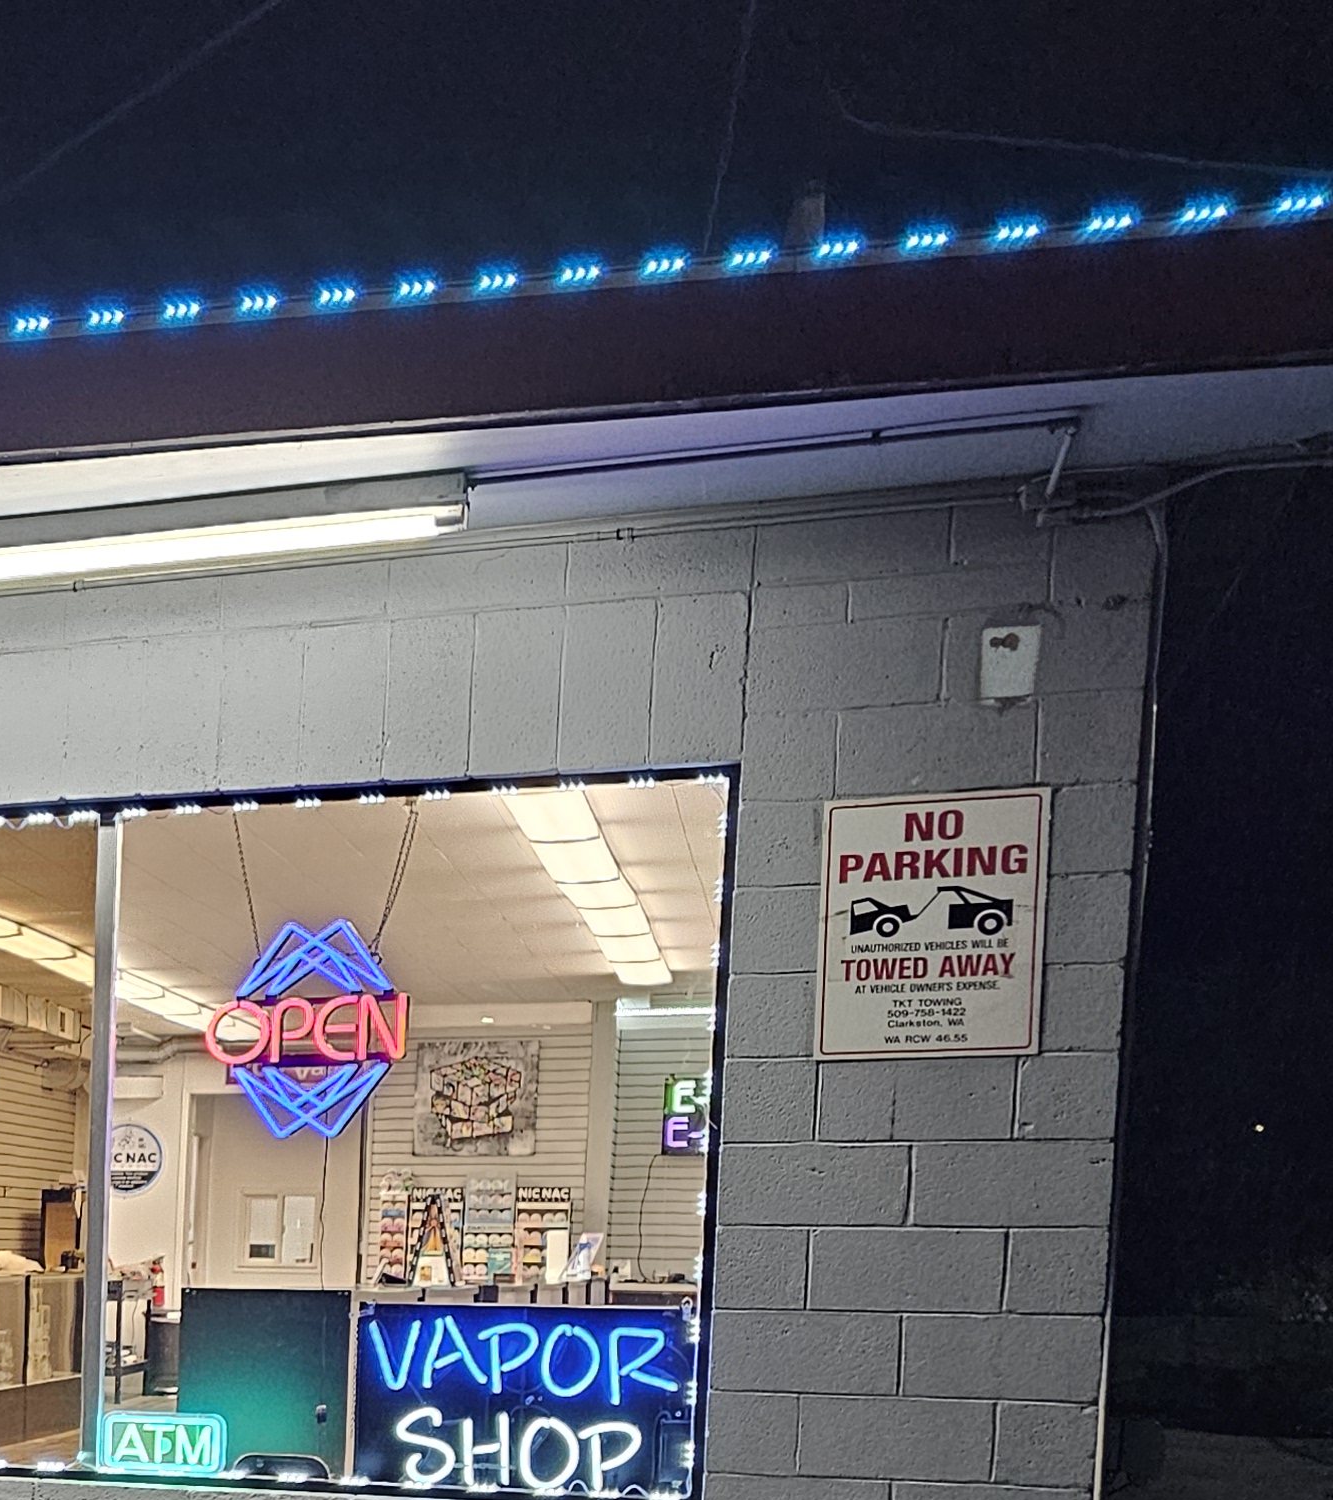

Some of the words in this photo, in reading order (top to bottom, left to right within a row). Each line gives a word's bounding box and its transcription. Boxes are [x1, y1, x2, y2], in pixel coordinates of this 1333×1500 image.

[904, 810, 964, 842] NO
[839, 844, 1028, 884] PARKING
[851, 942, 921, 954] UNAUTHORIZED
[924, 940, 968, 951] VEHICLES
[971, 938, 993, 949] WILL
[997, 938, 1009, 948] BE
[841, 957, 928, 982] TOWED
[938, 952, 1016, 978] AWAY
[855, 984, 866, 994] AT
[870, 983, 906, 994] VEHICLE
[909, 981, 953, 993] OWNER'S
[918, 997, 962, 1007] TOWING
[205, 991, 410, 1065] OPEN
[887, 1019, 943, 1028] Clarkston,
[947, 1018, 965, 1027] WA
[884, 1035, 901, 1044] WA
[905, 1034, 932, 1044] RCW
[935, 1033, 968, 1043] 46.55
[126, 1152, 157, 1163] NAC
[518, 1188, 540, 1200] NIC
[541, 1187, 570, 1200] NAC
[369, 1315, 678, 1405] VAPOR
[113, 1423, 213, 1466] ATM
[395, 1407, 642, 1490] SHOP
